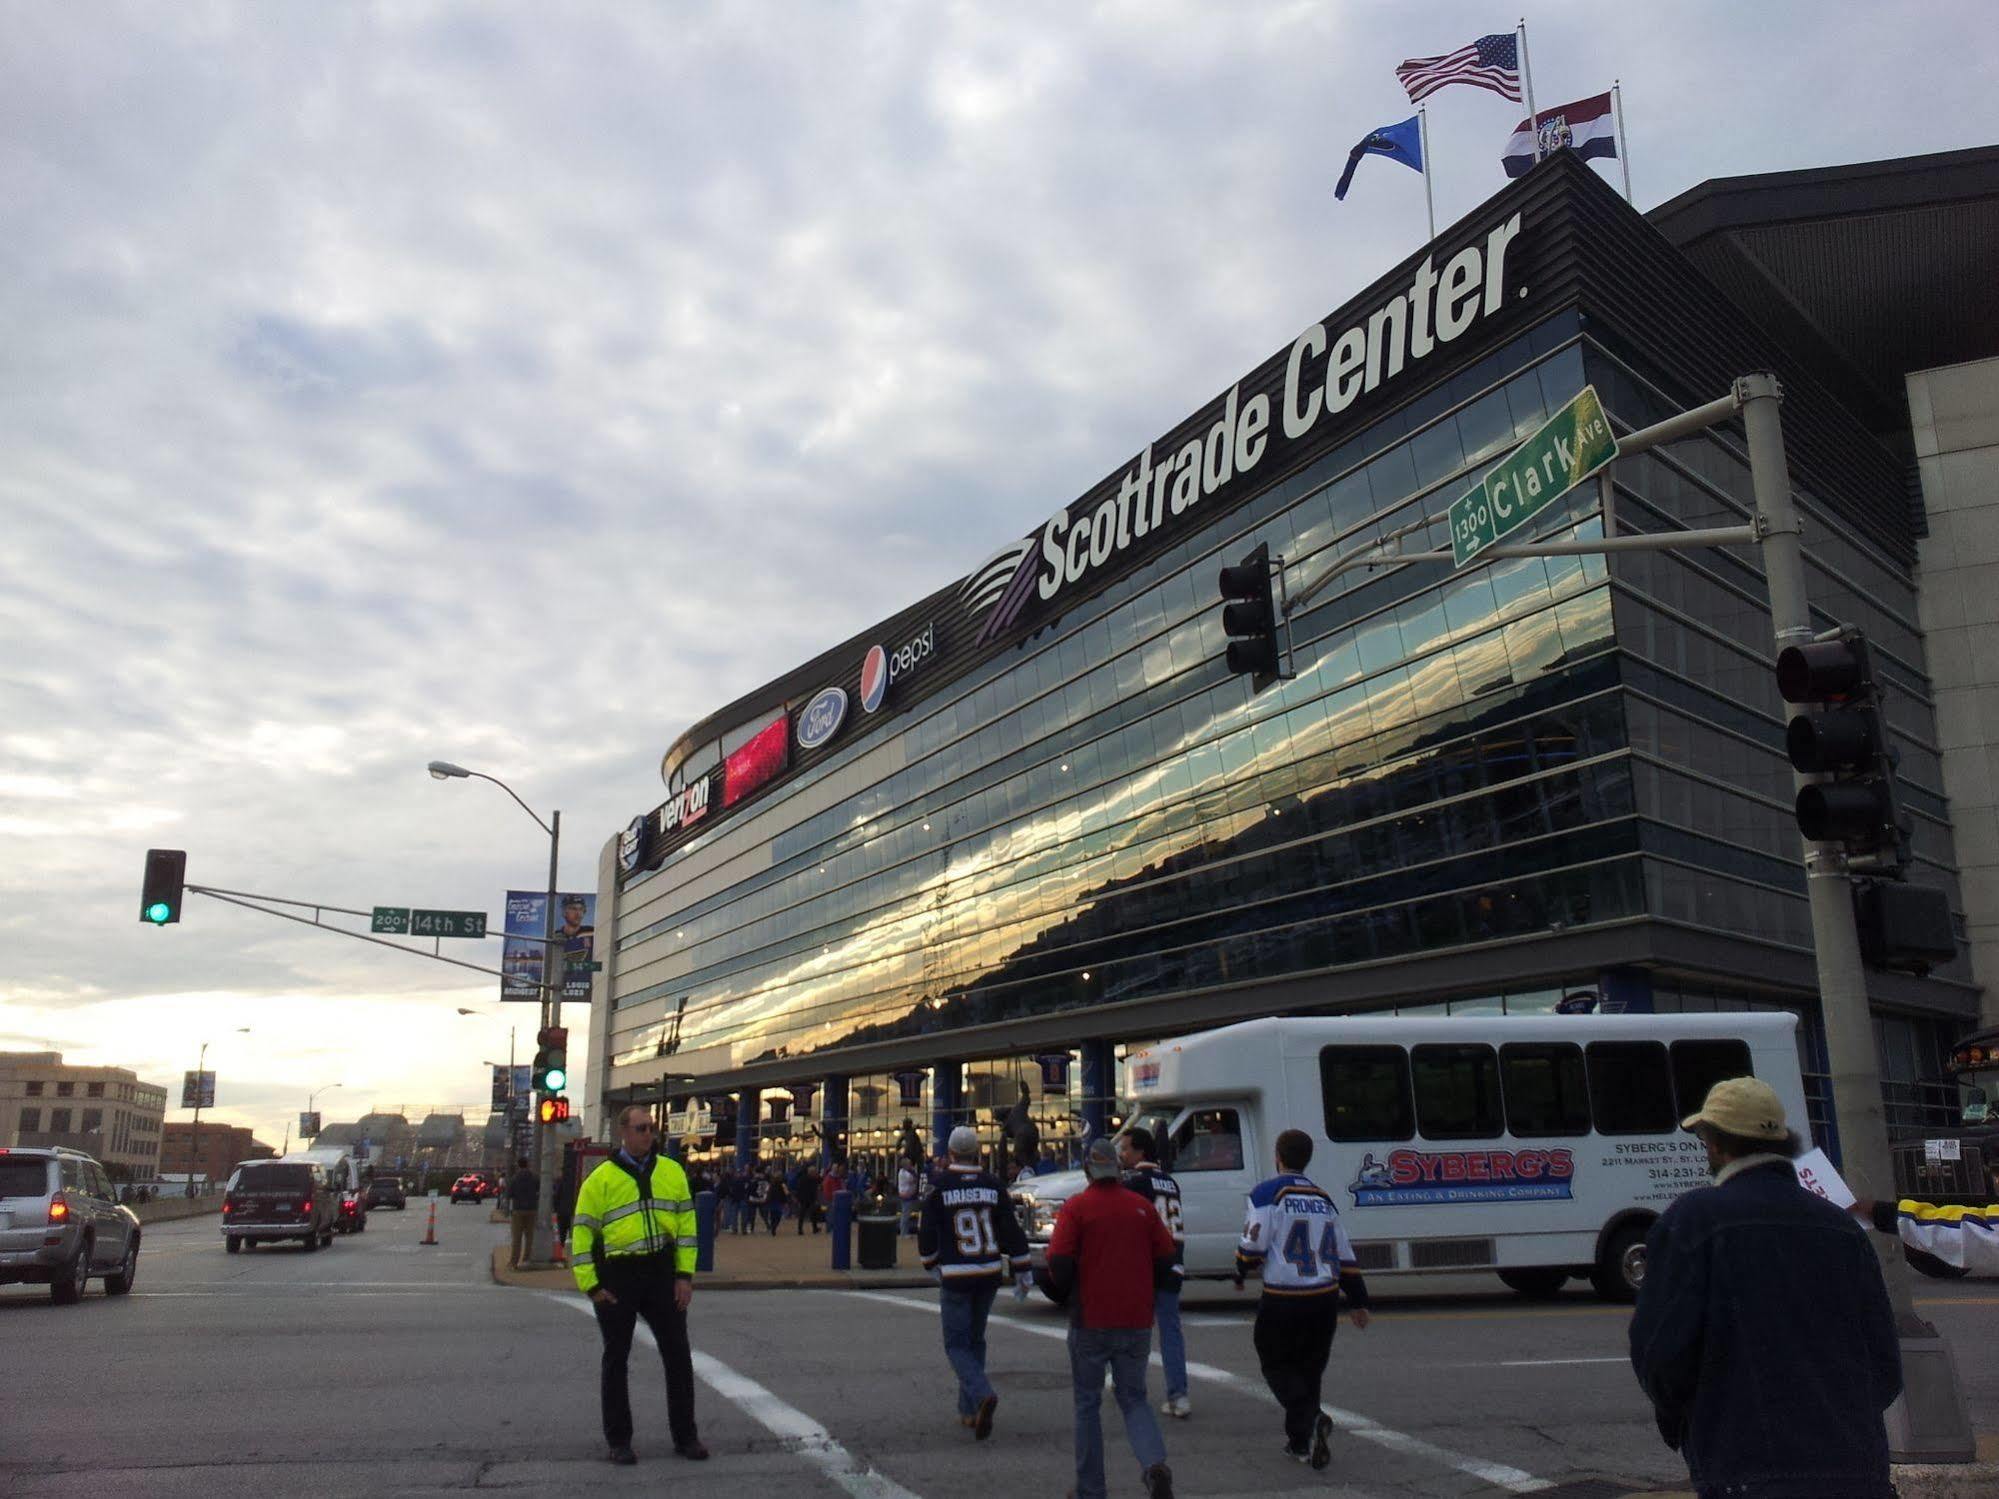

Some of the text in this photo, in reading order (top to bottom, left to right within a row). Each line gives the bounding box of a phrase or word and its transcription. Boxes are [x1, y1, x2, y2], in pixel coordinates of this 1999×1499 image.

[1038, 383, 1270, 600] Scottrade
[1455, 418, 1604, 543] 1300 Clark Ave
[889, 621, 934, 684] pepsi
[807, 700, 835, 738] Ford
[660, 776, 710, 834] verizon
[376, 915, 401, 925] 200
[415, 915, 484, 933] 14th St
[1391, 1150, 1574, 1184] SYBERG'S
[1615, 1142, 1677, 1154] SYBERG'S
[1680, 1141, 1698, 1152] ON
[1798, 1166, 1832, 1201] ETS
[954, 1208, 999, 1256] 91
[1283, 1219, 1341, 1281] 44
